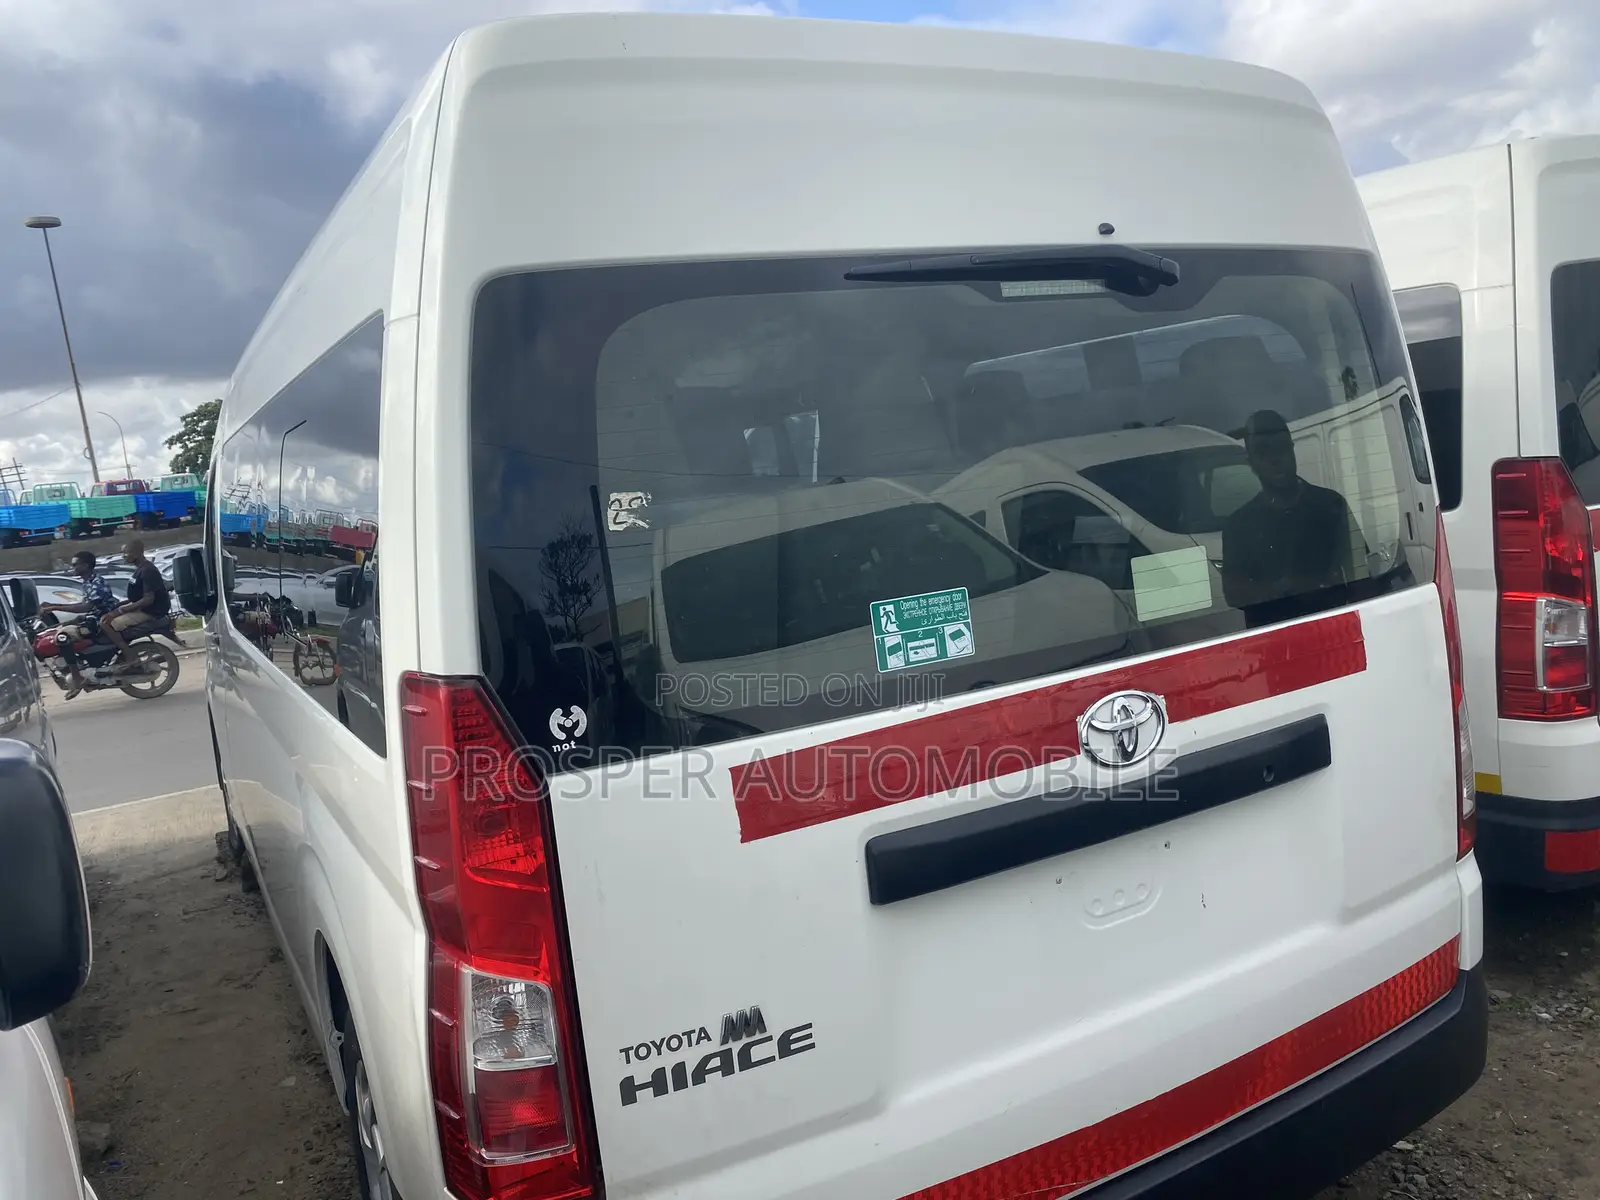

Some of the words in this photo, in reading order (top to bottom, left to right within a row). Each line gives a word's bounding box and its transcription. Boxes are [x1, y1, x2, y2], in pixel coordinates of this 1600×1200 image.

[900, 600, 918, 611] Opening
[928, 595, 951, 606] emergency
[952, 592, 962, 601] door
[552, 740, 577, 752] not
[619, 1026, 712, 1065] TOYOTA
[619, 1022, 816, 1107] HIACE
